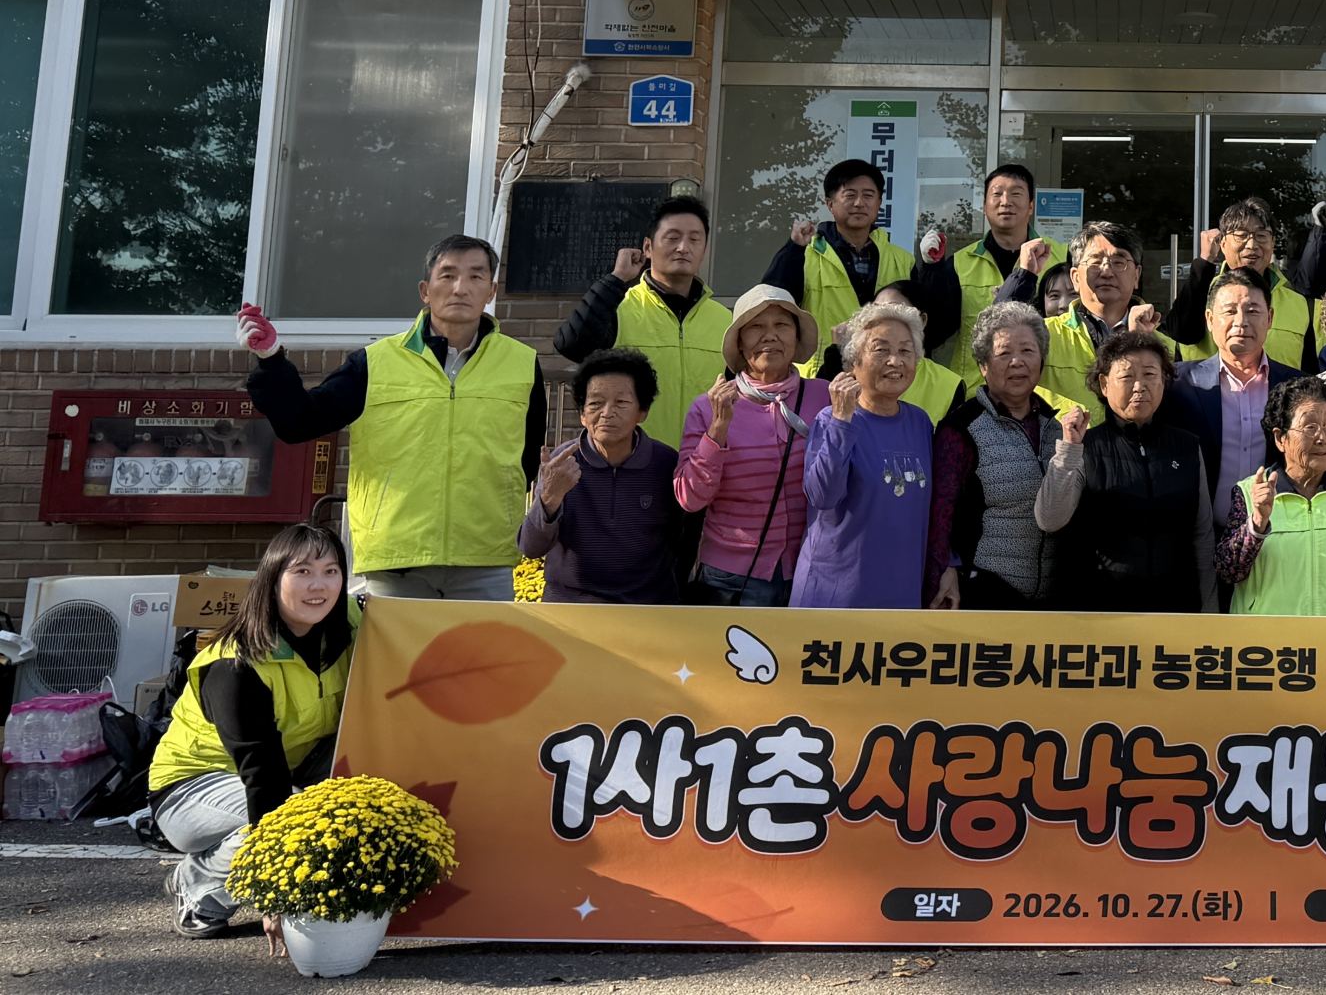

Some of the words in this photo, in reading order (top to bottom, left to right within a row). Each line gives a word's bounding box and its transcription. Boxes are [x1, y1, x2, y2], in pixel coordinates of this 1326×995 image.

[604, 23, 639, 33] 화재없는
[641, 23, 677, 34] 안전마을
[642, 99, 677, 119] 44
[151, 602, 169, 612] LG
[199, 599, 240, 616] 스위트
[800, 640, 1142, 689] 천사우리봉사단과
[1151, 645, 1317, 693] 농협은행
[546, 721, 834, 847] 1사1촌
[842, 727, 1212, 853] 사랑나눔
[913, 892, 961, 918] 일자
